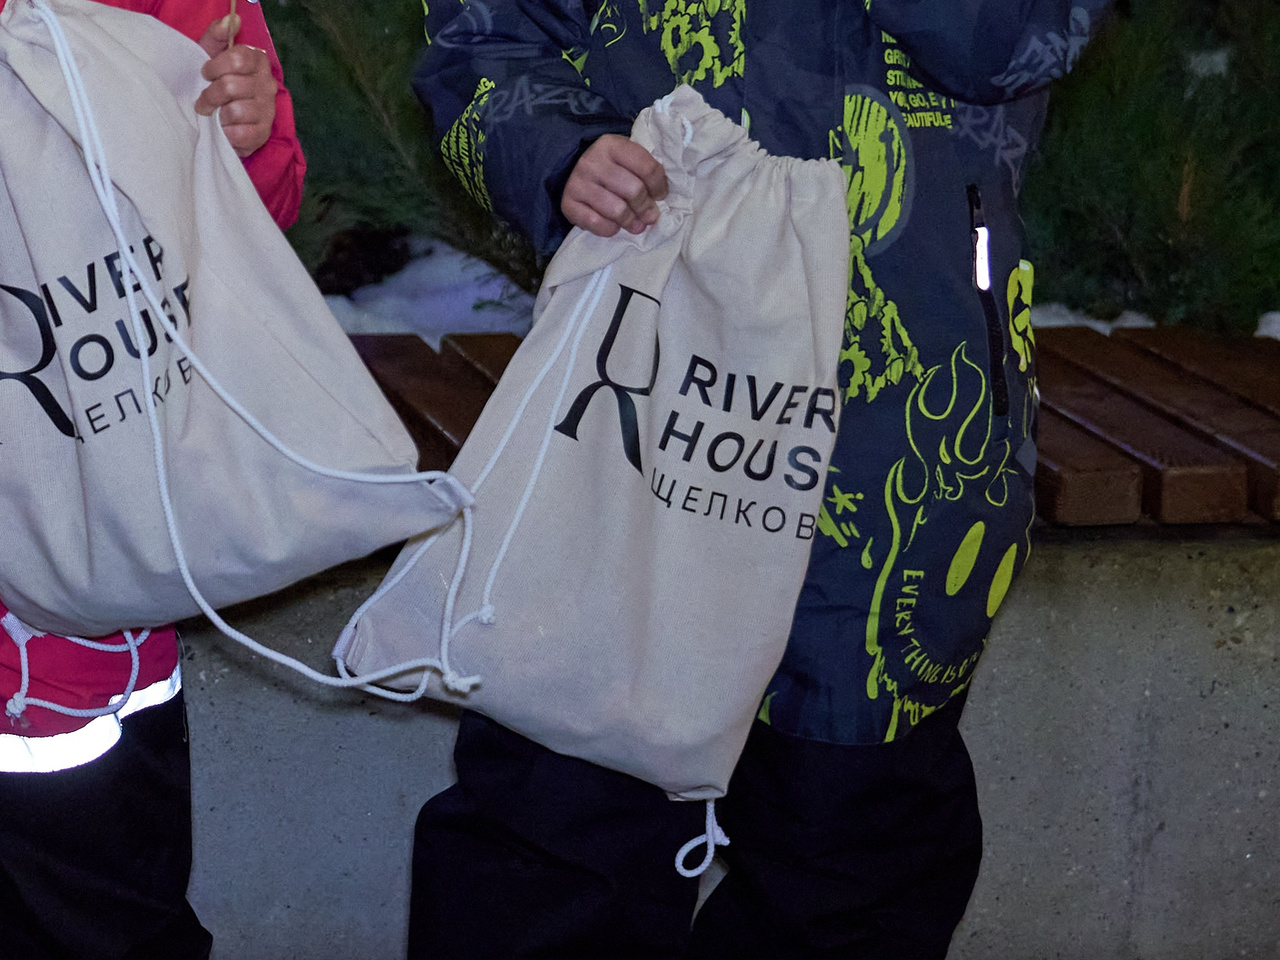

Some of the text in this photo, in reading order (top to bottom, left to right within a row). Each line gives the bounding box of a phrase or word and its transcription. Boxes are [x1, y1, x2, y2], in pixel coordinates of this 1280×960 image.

[41, 235, 163, 327] IVER
[679, 354, 836, 433] RIVER
[658, 410, 821, 491] HOUS
[651, 467, 816, 540] ЩЕЛКОВ
